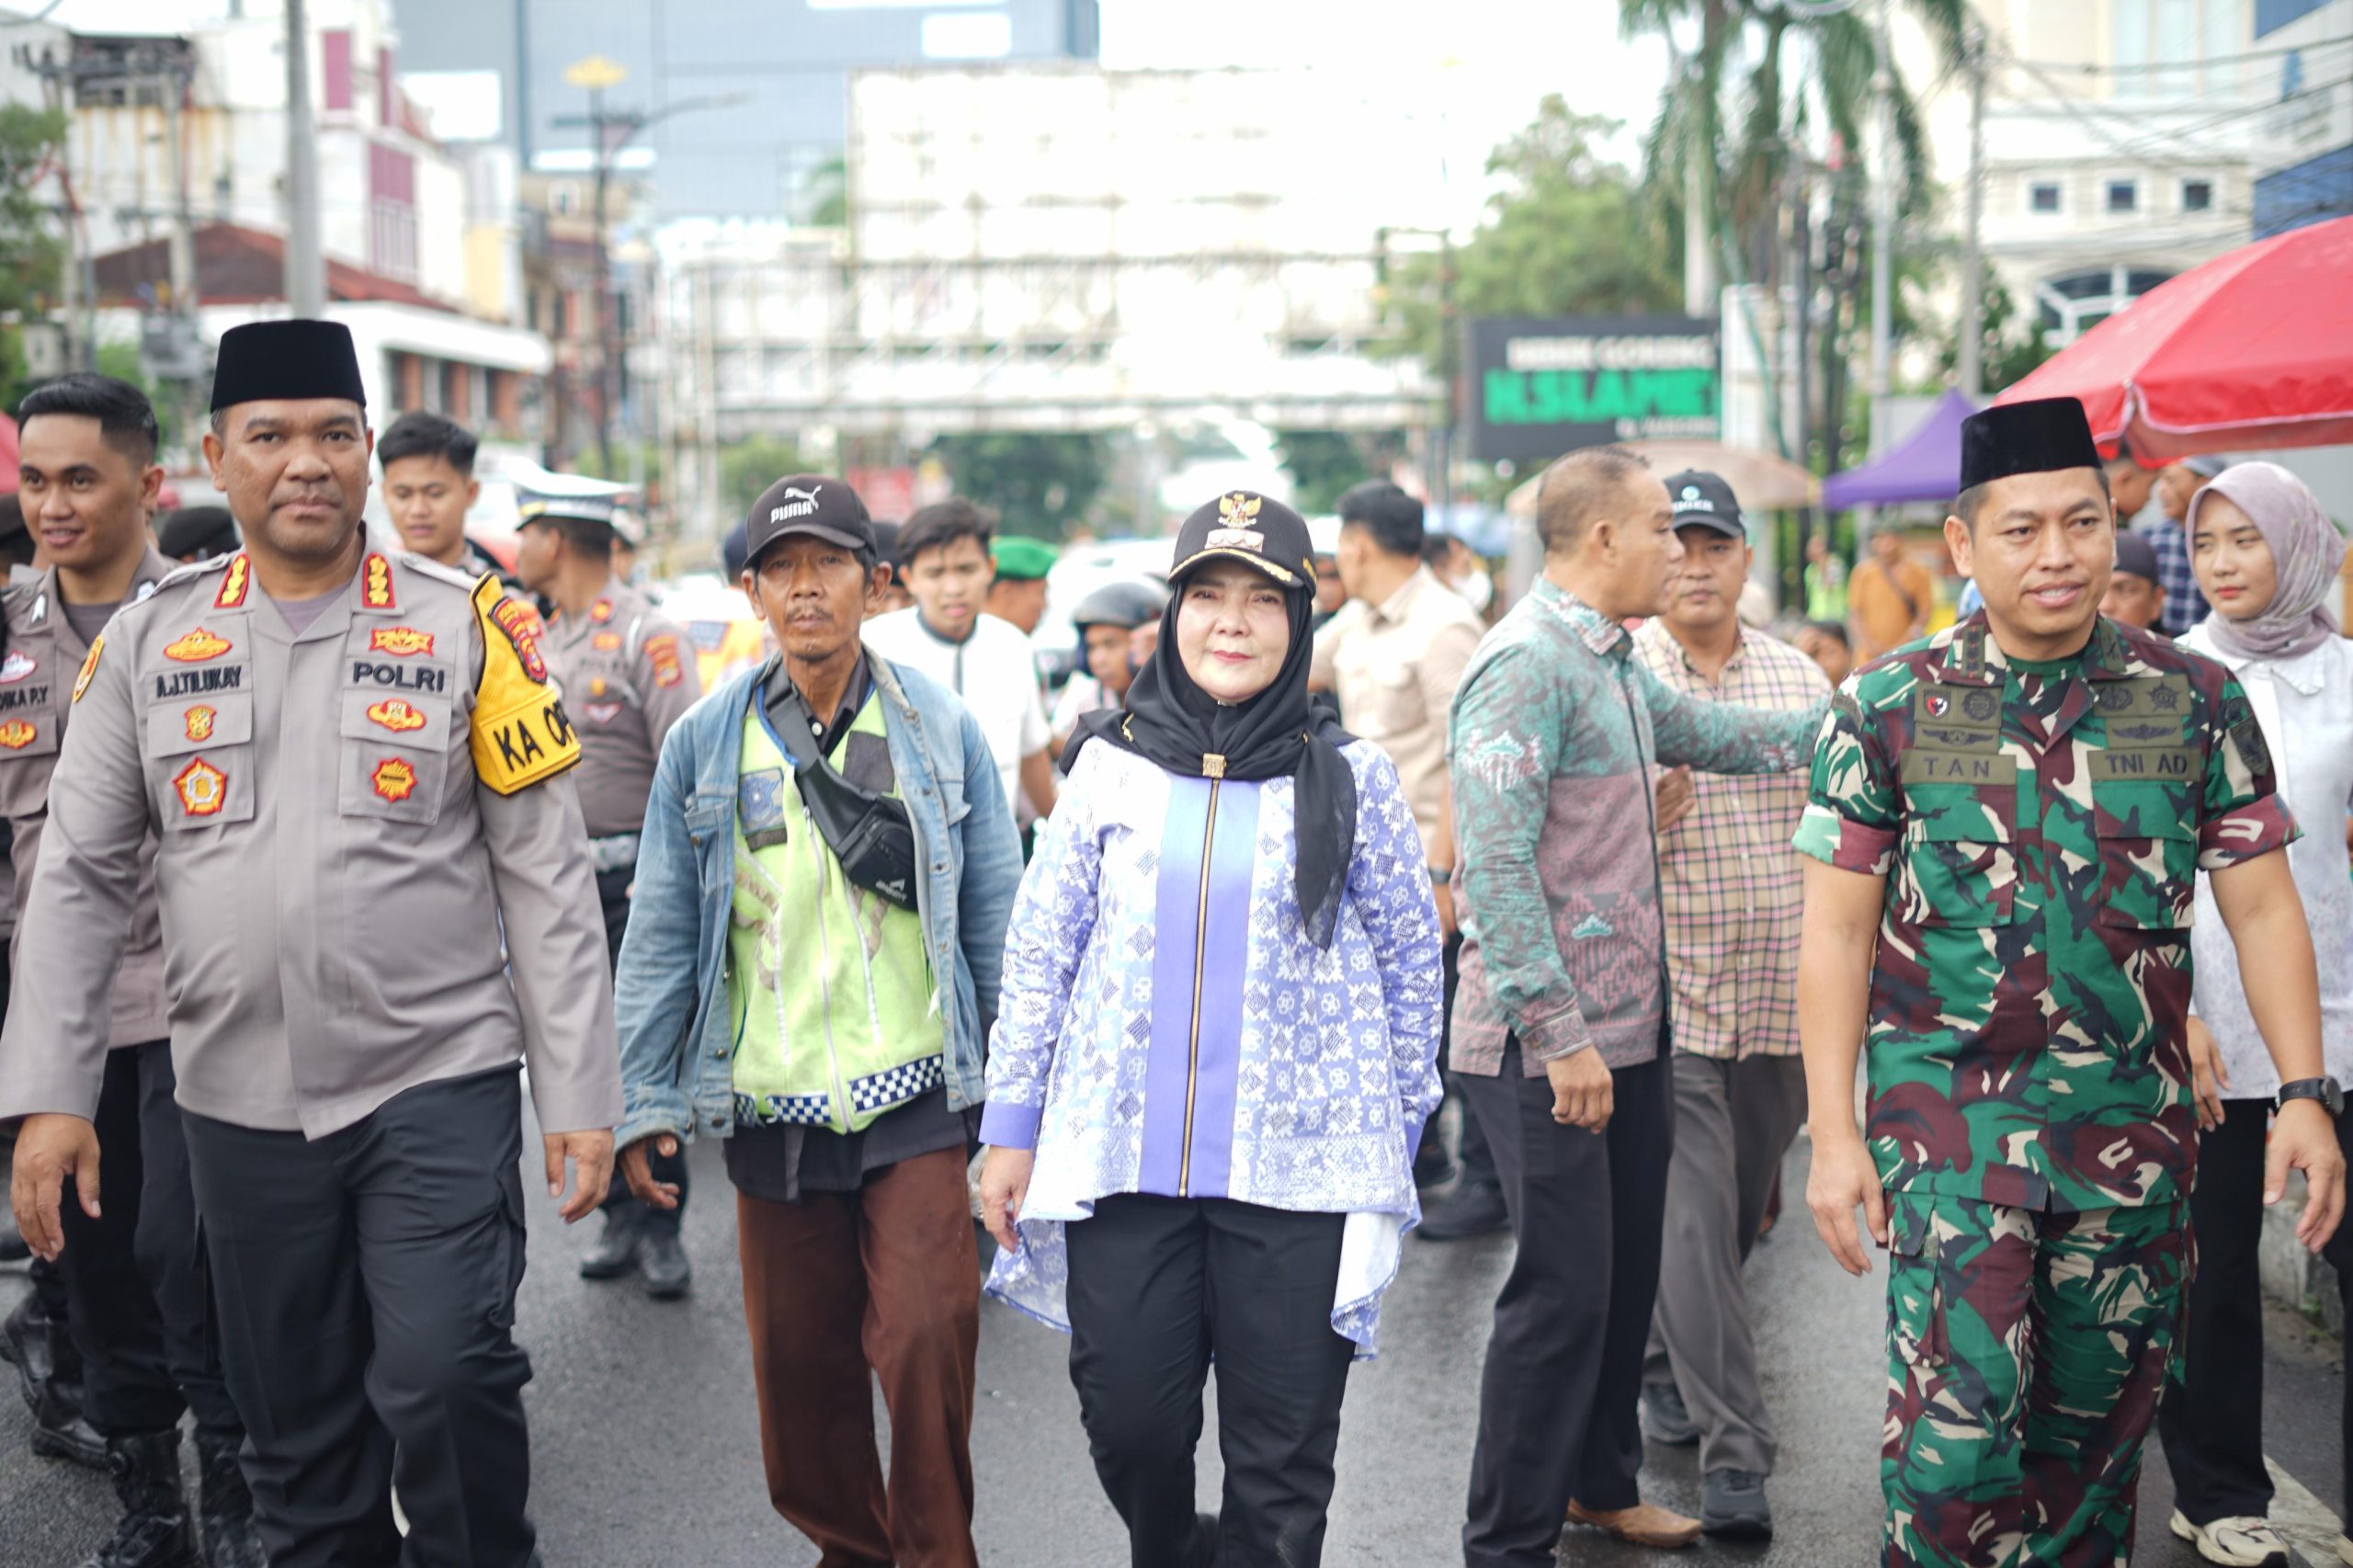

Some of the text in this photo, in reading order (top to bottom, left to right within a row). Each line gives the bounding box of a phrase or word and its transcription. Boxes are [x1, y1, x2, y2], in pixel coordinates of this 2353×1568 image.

[770, 501, 813, 524] PUMA
[353, 662, 445, 692] POLRI
[493, 719, 544, 773] KA
[1924, 757, 1990, 778] TAN
[2105, 753, 2188, 774] TNI AD
